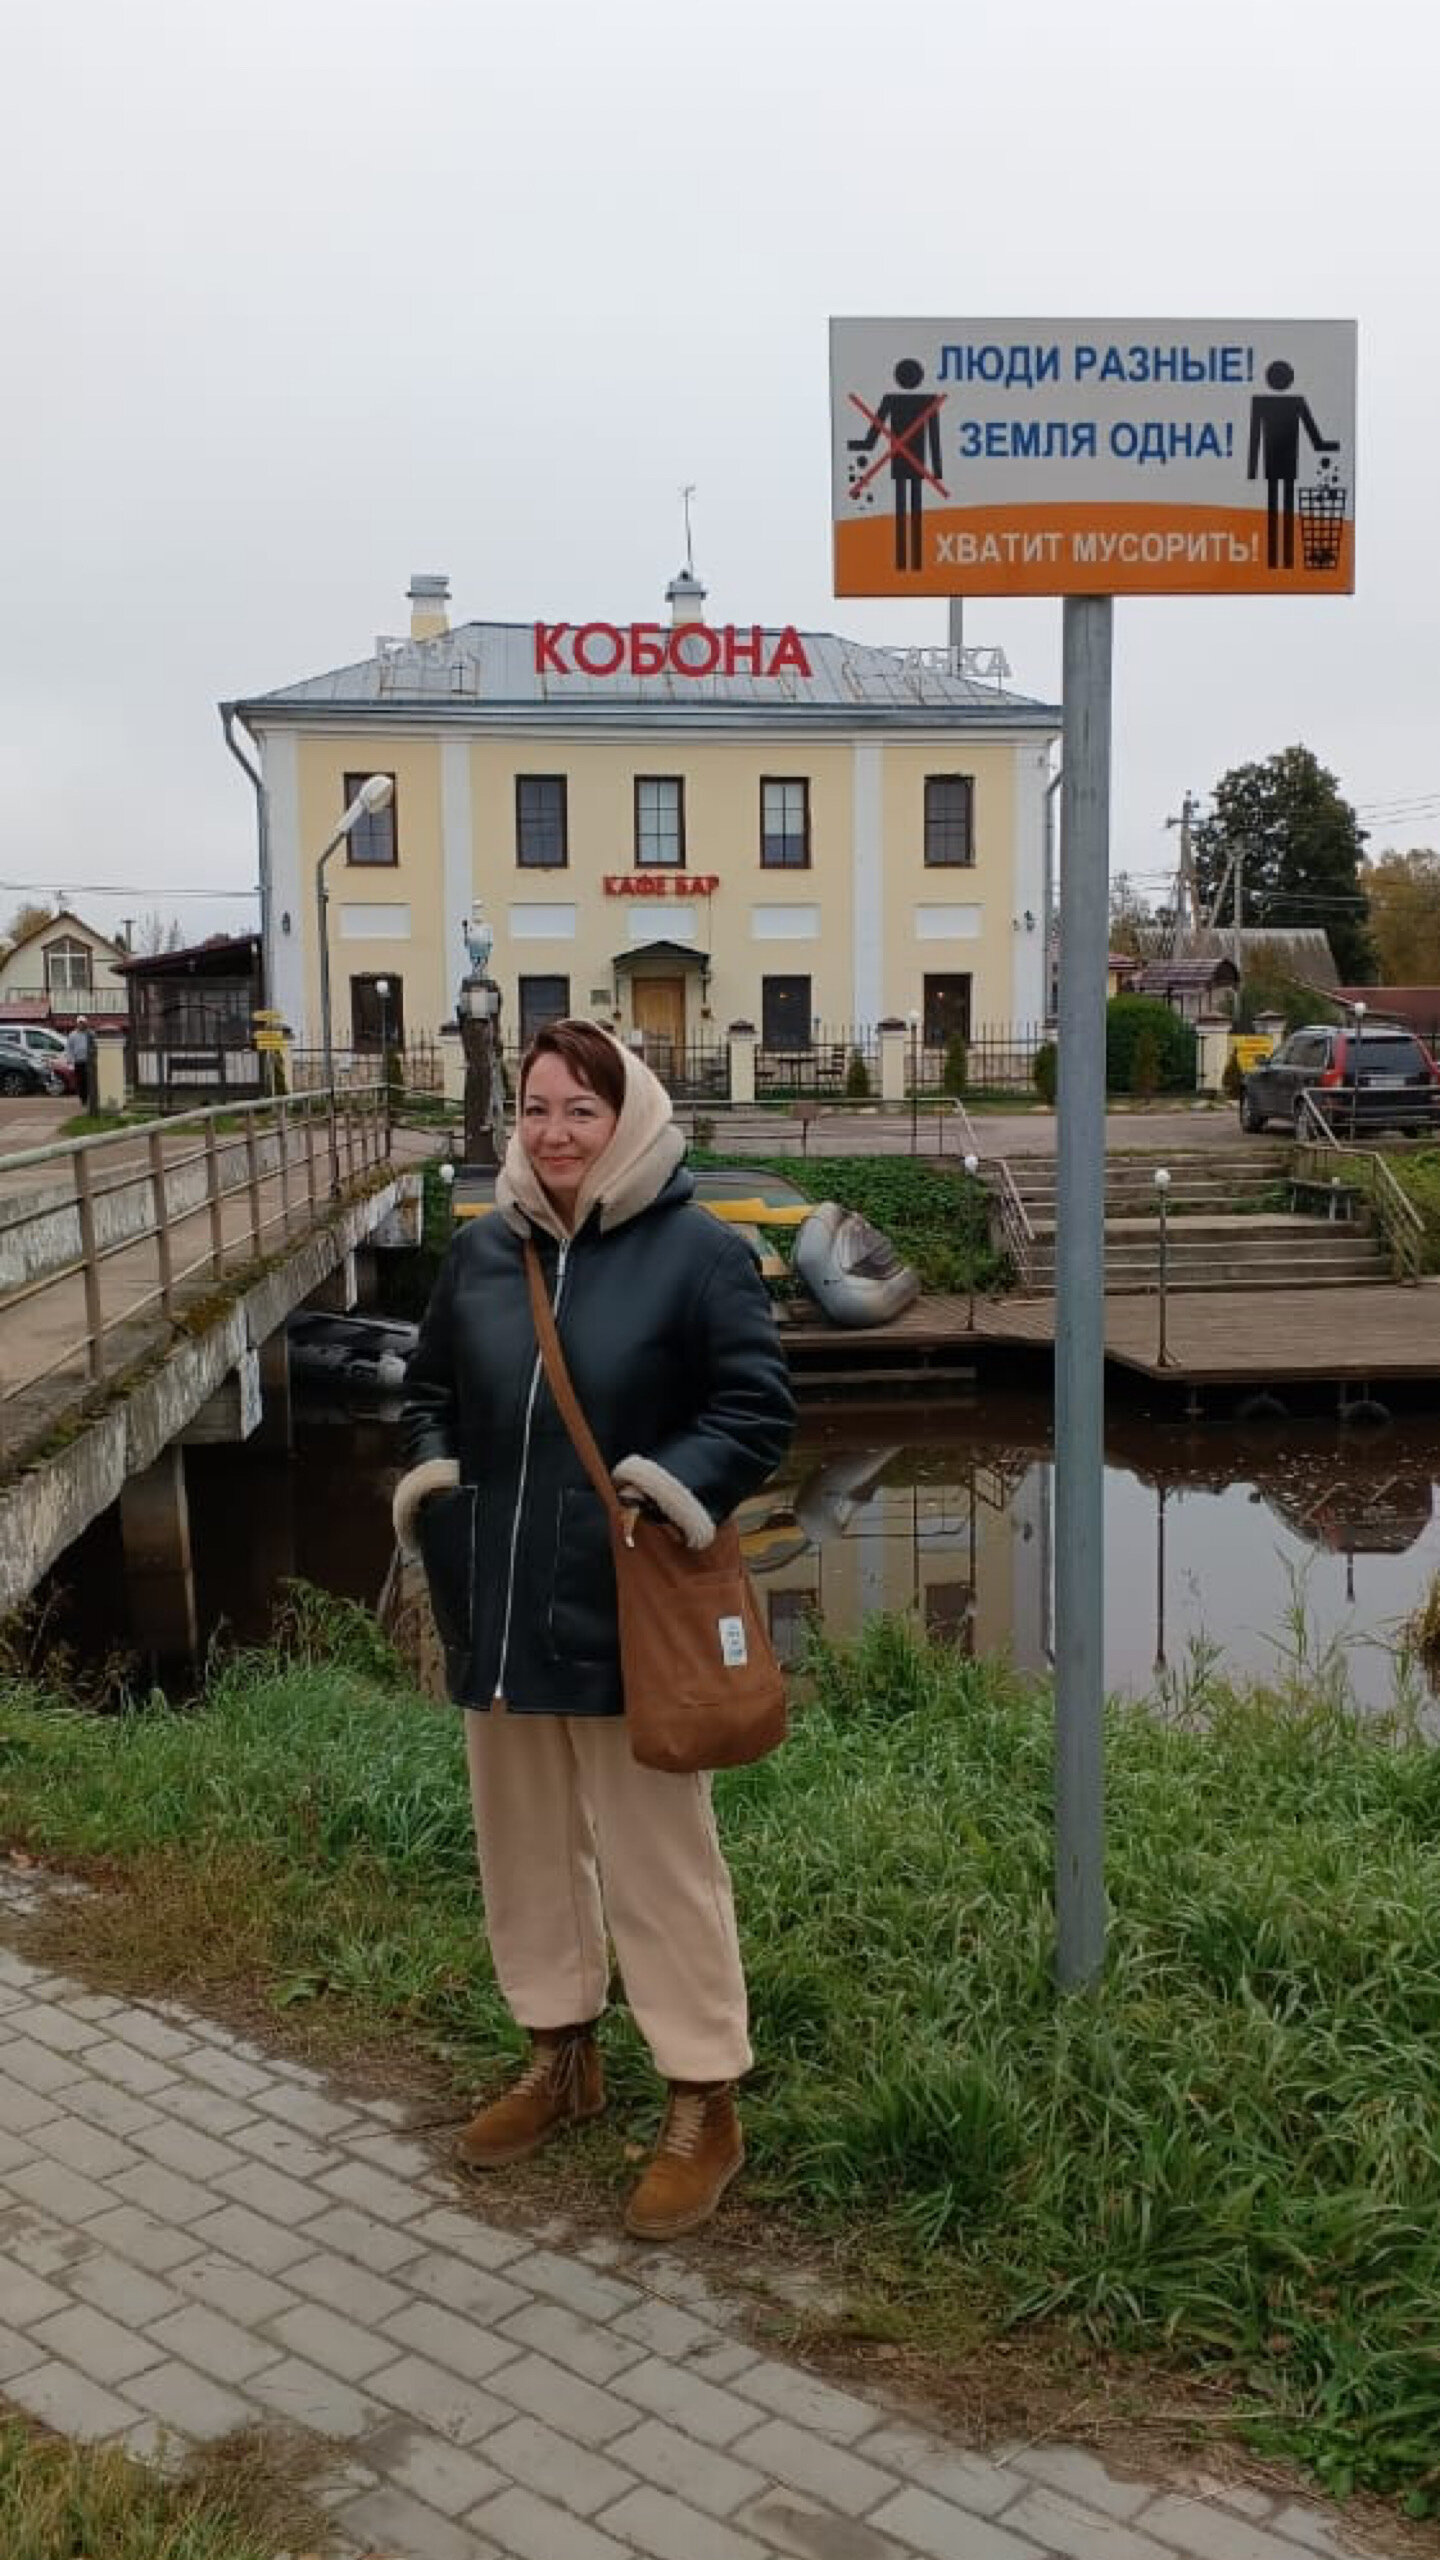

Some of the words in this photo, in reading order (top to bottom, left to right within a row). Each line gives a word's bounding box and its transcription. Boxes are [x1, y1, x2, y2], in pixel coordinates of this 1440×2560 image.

[936, 345, 1061, 389] ЛЮДИ
[1074, 345, 1255, 383] РАЗНЫЕ!
[958, 422, 1097, 458] ЗЕМЛЯ
[1110, 422, 1234, 465] ОДНА!
[935, 532, 1063, 563] ХВАТИТ
[1072, 532, 1260, 563] МУСОРИТЬ!
[533, 621, 813, 678] КОБОНА
